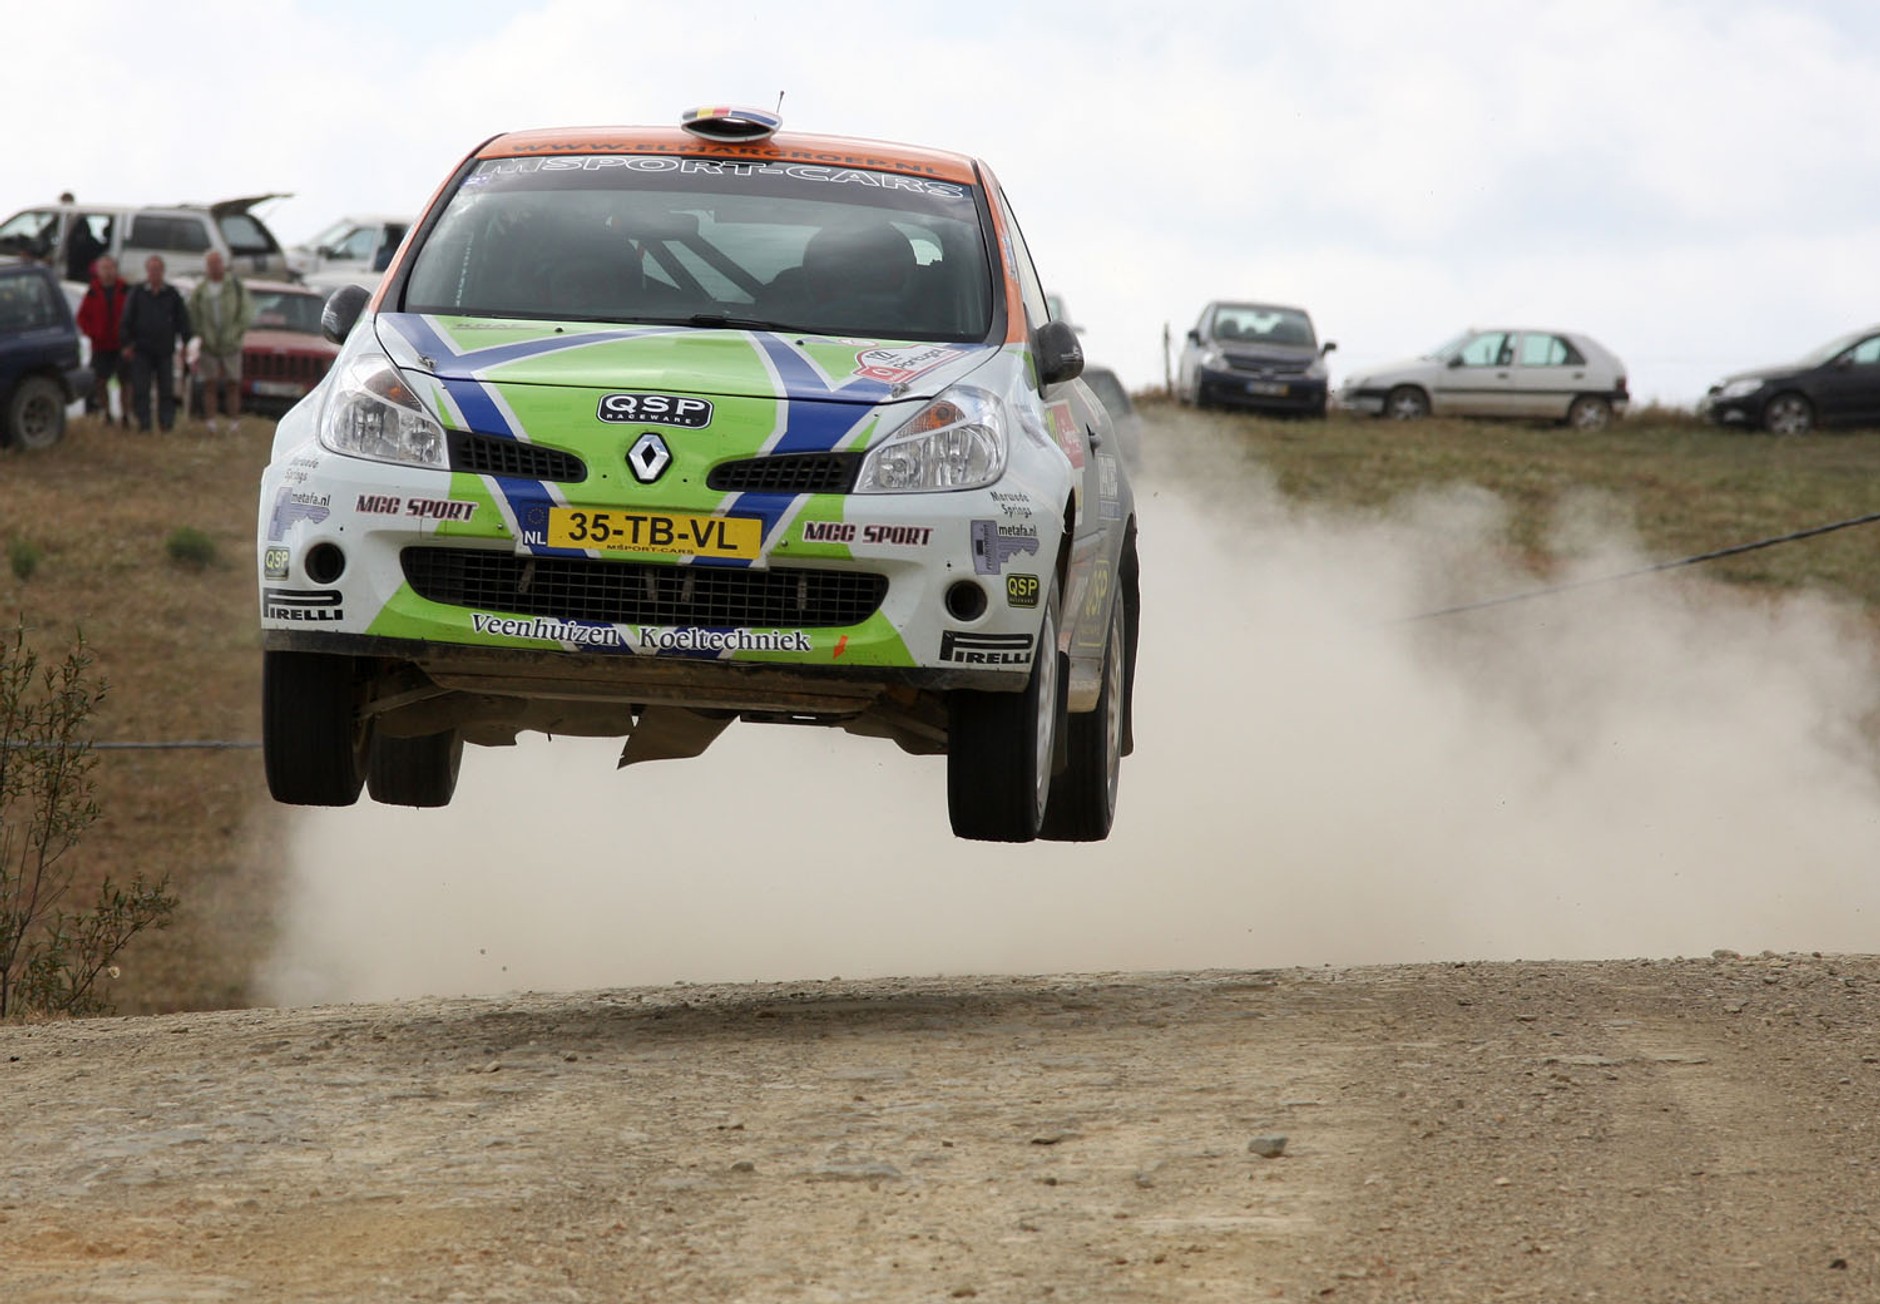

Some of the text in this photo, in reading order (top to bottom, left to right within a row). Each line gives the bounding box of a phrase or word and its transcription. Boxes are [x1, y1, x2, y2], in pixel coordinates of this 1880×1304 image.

[605, 395, 706, 415] QSP
[606, 413, 692, 424] RACEWARE
[405, 498, 478, 520] SPORT
[524, 531, 546, 545] NL
[568, 512, 738, 550] 35-TB-VL
[862, 524, 933, 546] SPORT
[266, 551, 288, 569] QSP
[1008, 577, 1038, 596] QSP
[263, 587, 343, 620] PIRELLI
[471, 613, 812, 651] Veenhuizen Koeltechniek
[939, 630, 1034, 664] PIRELLI
